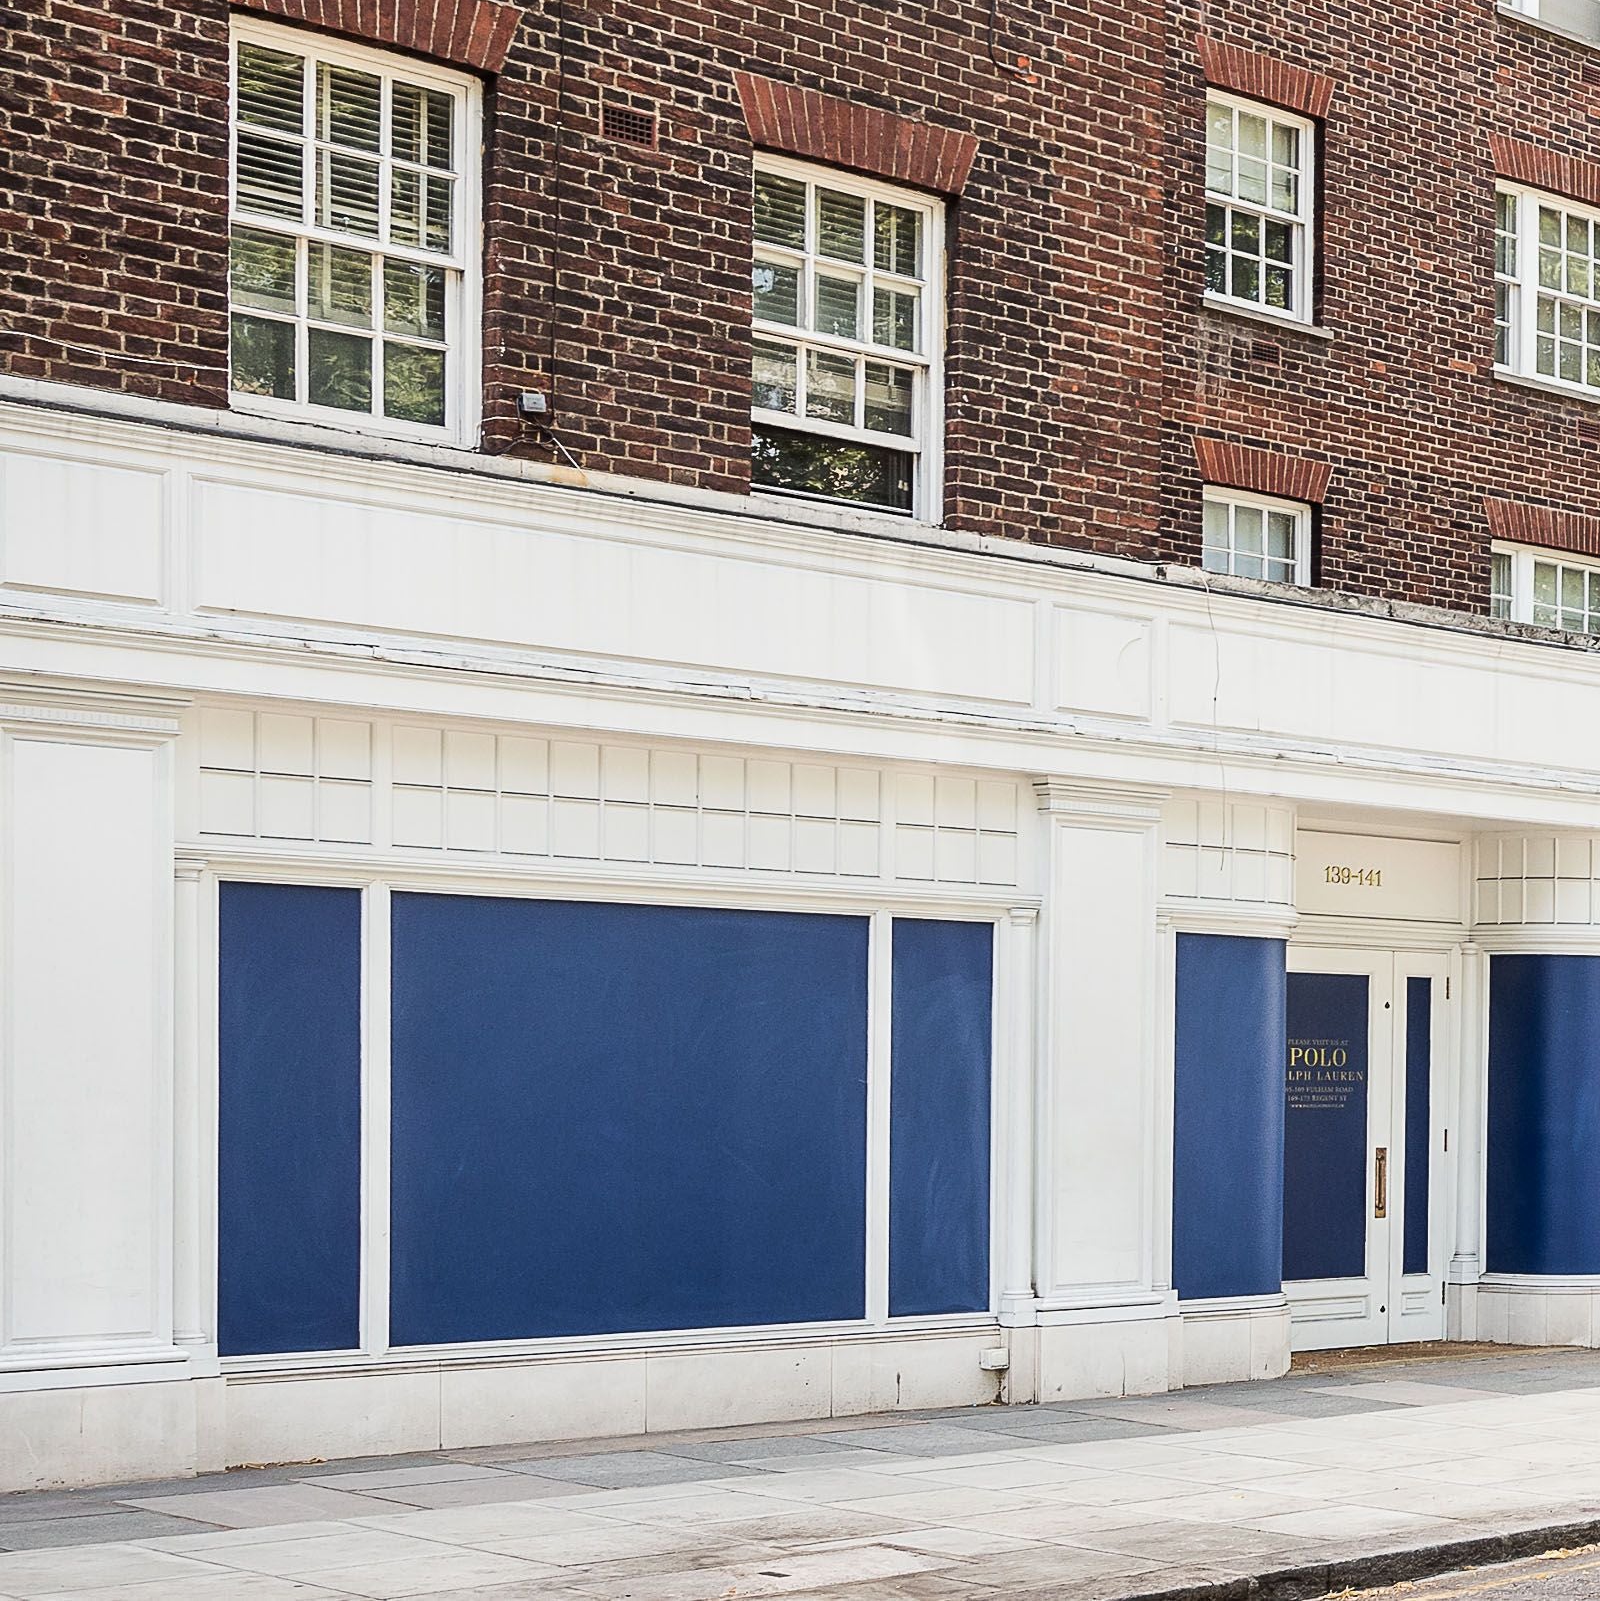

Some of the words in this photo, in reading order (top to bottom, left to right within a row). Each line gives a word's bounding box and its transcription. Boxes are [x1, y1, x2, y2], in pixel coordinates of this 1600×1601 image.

[1324, 865, 1382, 887] 139-141
[1290, 1047, 1347, 1067] POLO
[1286, 1070, 1311, 1081] LPH
[1317, 1070, 1364, 1081] LAUREN
